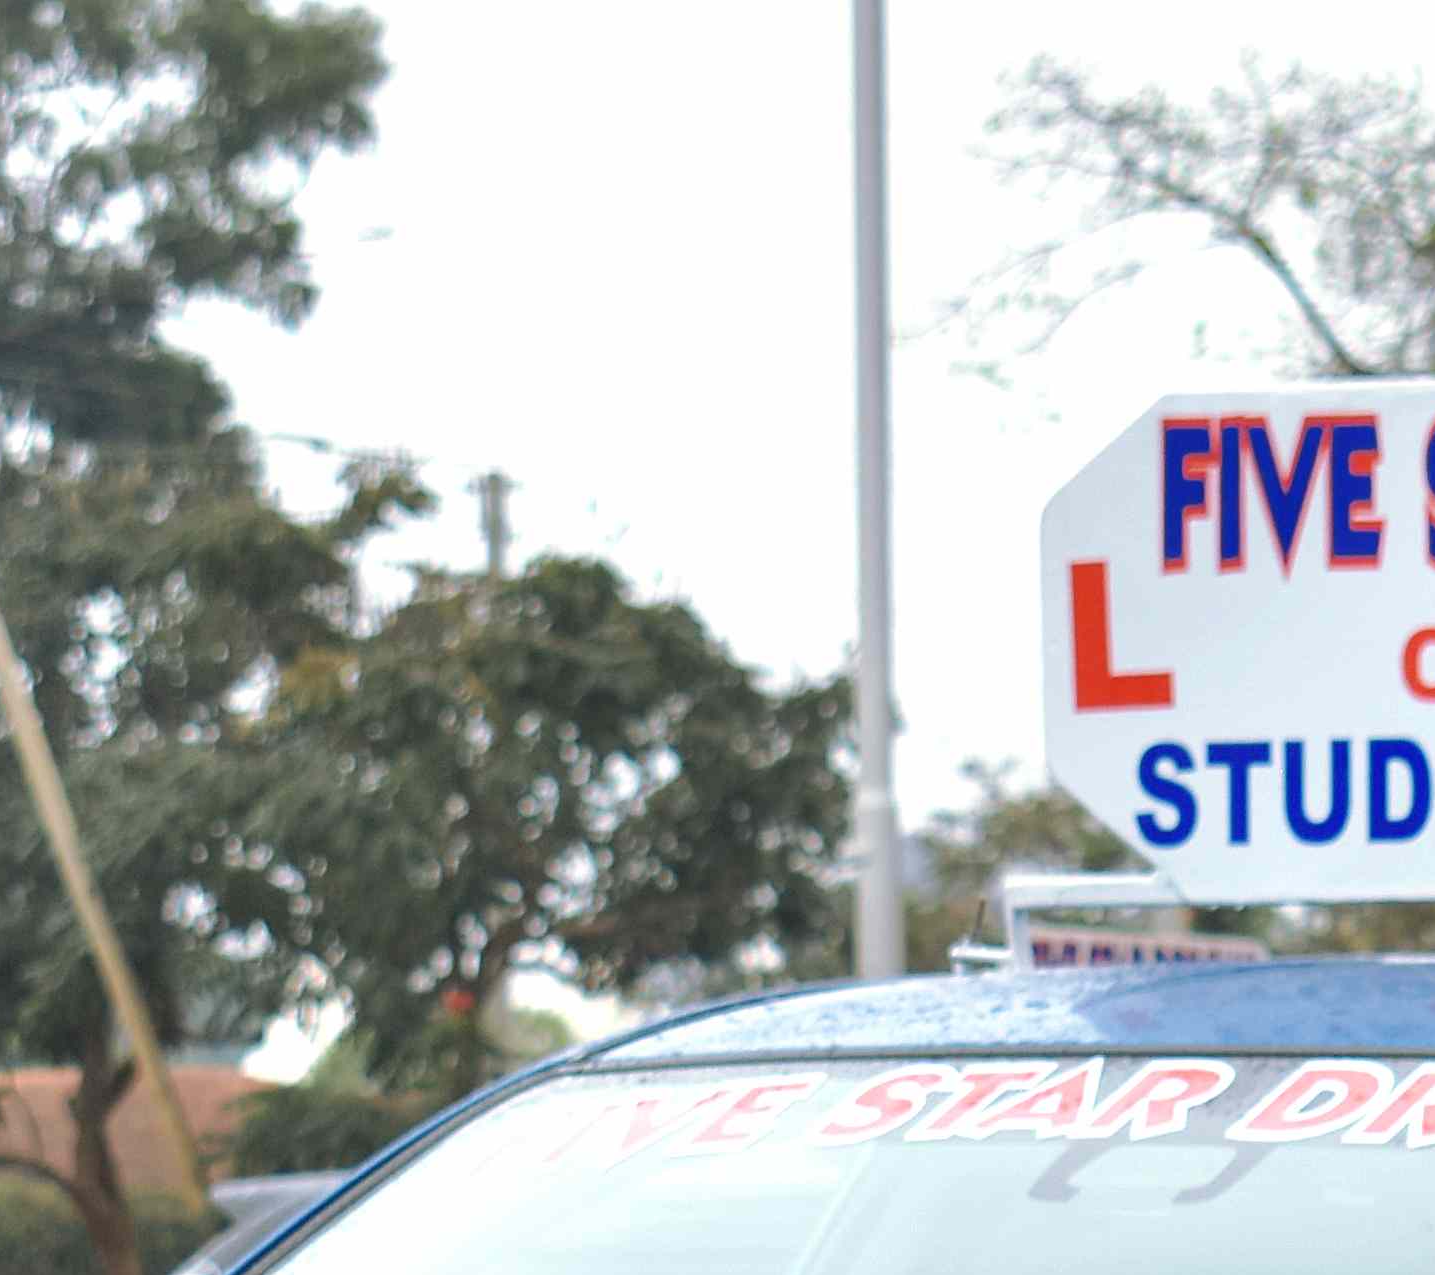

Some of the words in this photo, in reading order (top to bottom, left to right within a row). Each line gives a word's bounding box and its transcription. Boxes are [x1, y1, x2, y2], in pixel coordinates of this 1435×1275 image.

[1160, 415, 1386, 580] FIVE
[1069, 561, 1175, 714] L
[496, 1072, 828, 1175] IVE
[811, 1056, 1234, 1144] STAR
